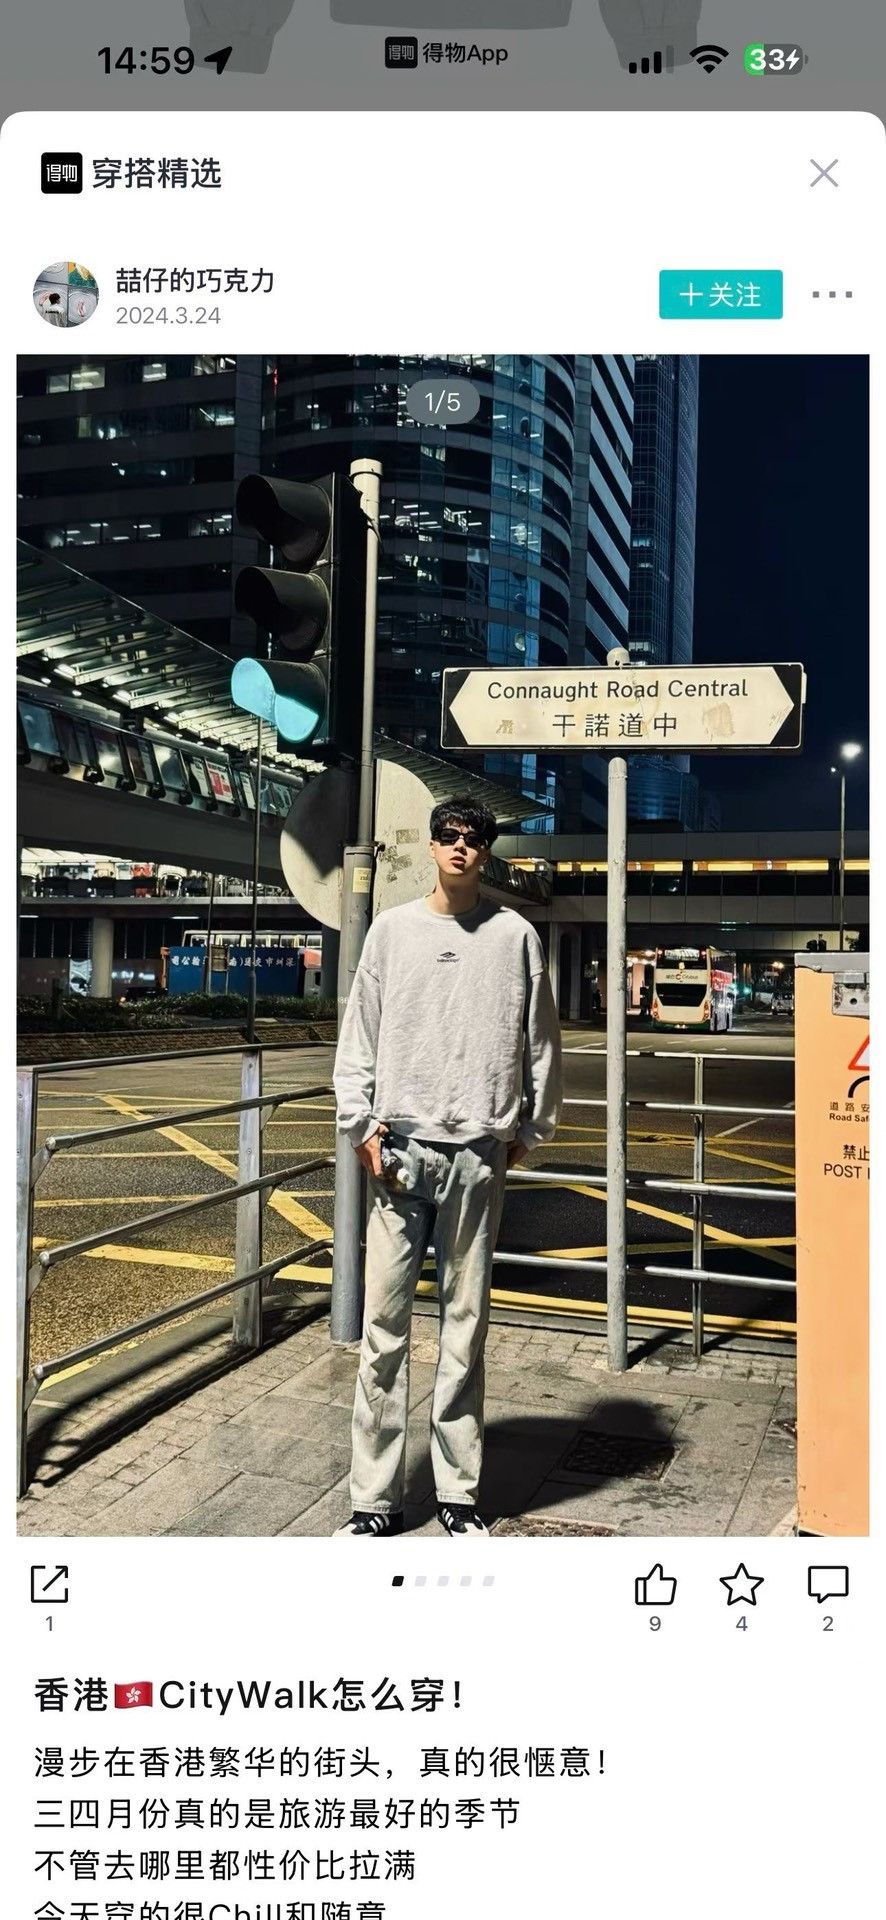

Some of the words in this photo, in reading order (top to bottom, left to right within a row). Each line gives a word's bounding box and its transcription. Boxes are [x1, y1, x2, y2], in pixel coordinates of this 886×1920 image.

[487, 681, 598, 703] Connaught
[606, 681, 657, 699] Road
[667, 678, 748, 698] Central
[552, 712, 678, 738] 干諾道中
[829, 1112, 852, 1122] Road
[843, 1144, 869, 1161] 禁止
[823, 1162, 863, 1179] POST
